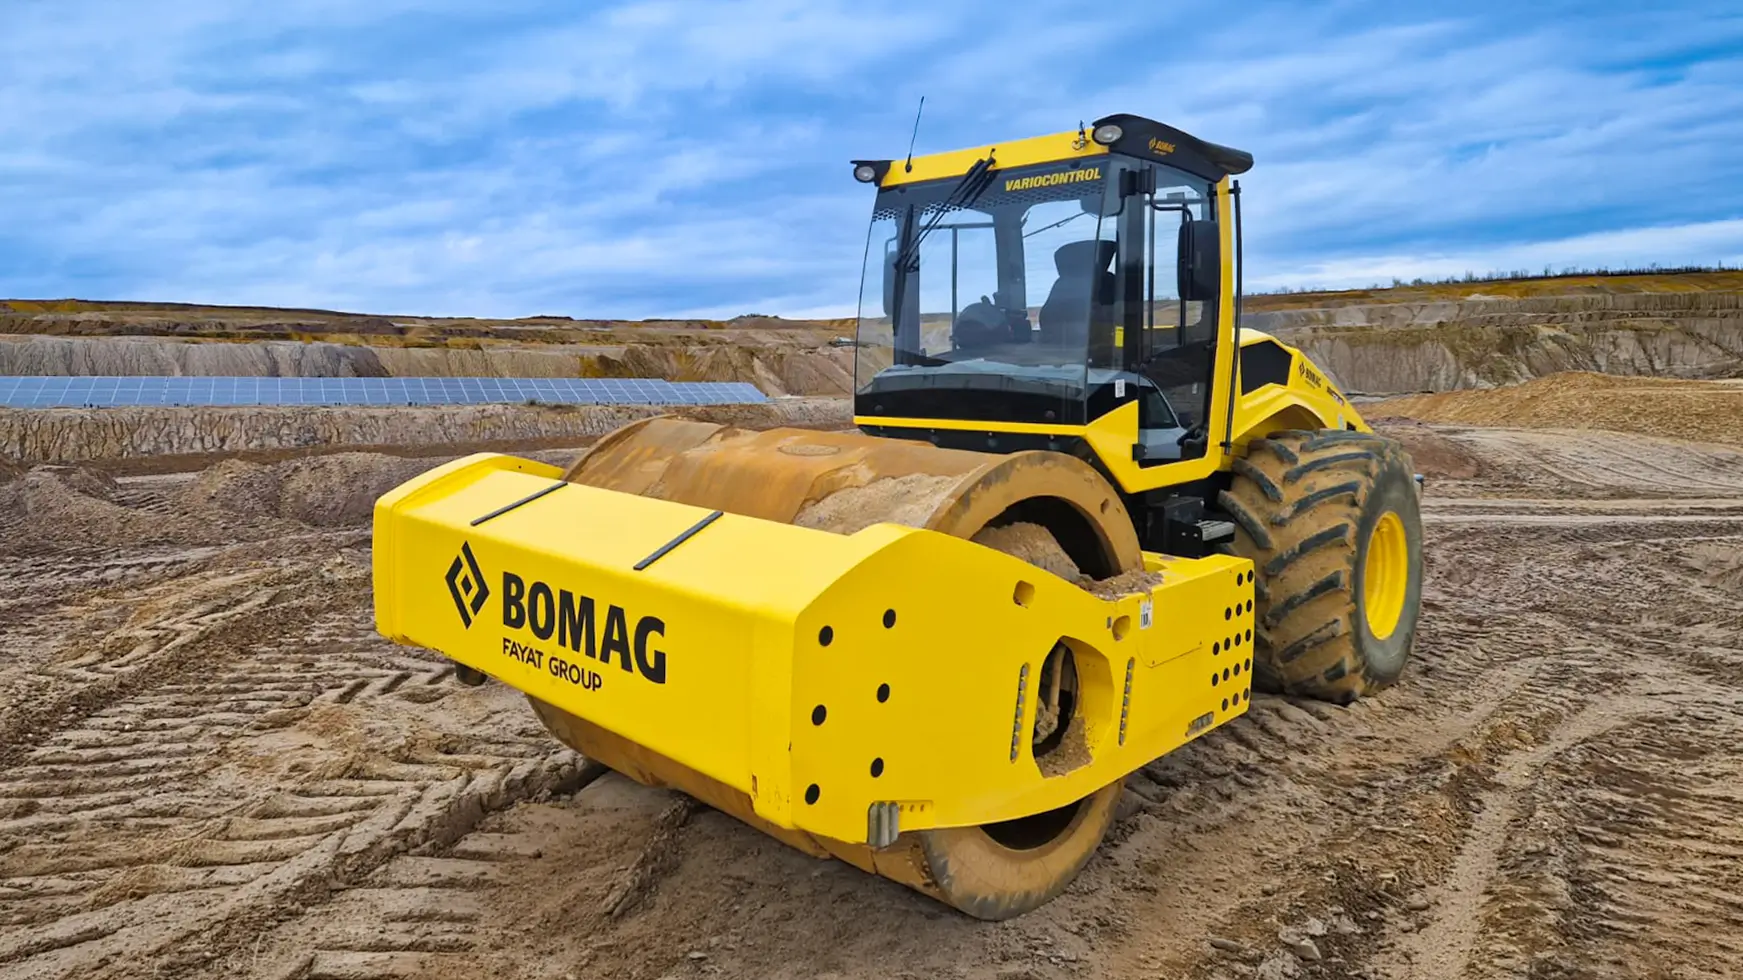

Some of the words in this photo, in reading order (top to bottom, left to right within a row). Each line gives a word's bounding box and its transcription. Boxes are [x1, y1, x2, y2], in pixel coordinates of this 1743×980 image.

[1005, 168, 1101, 192] VARIOCONTROL
[503, 571, 666, 684] BOMAG
[503, 637, 543, 669] FAYAT
[549, 656, 602, 691] GROUP
